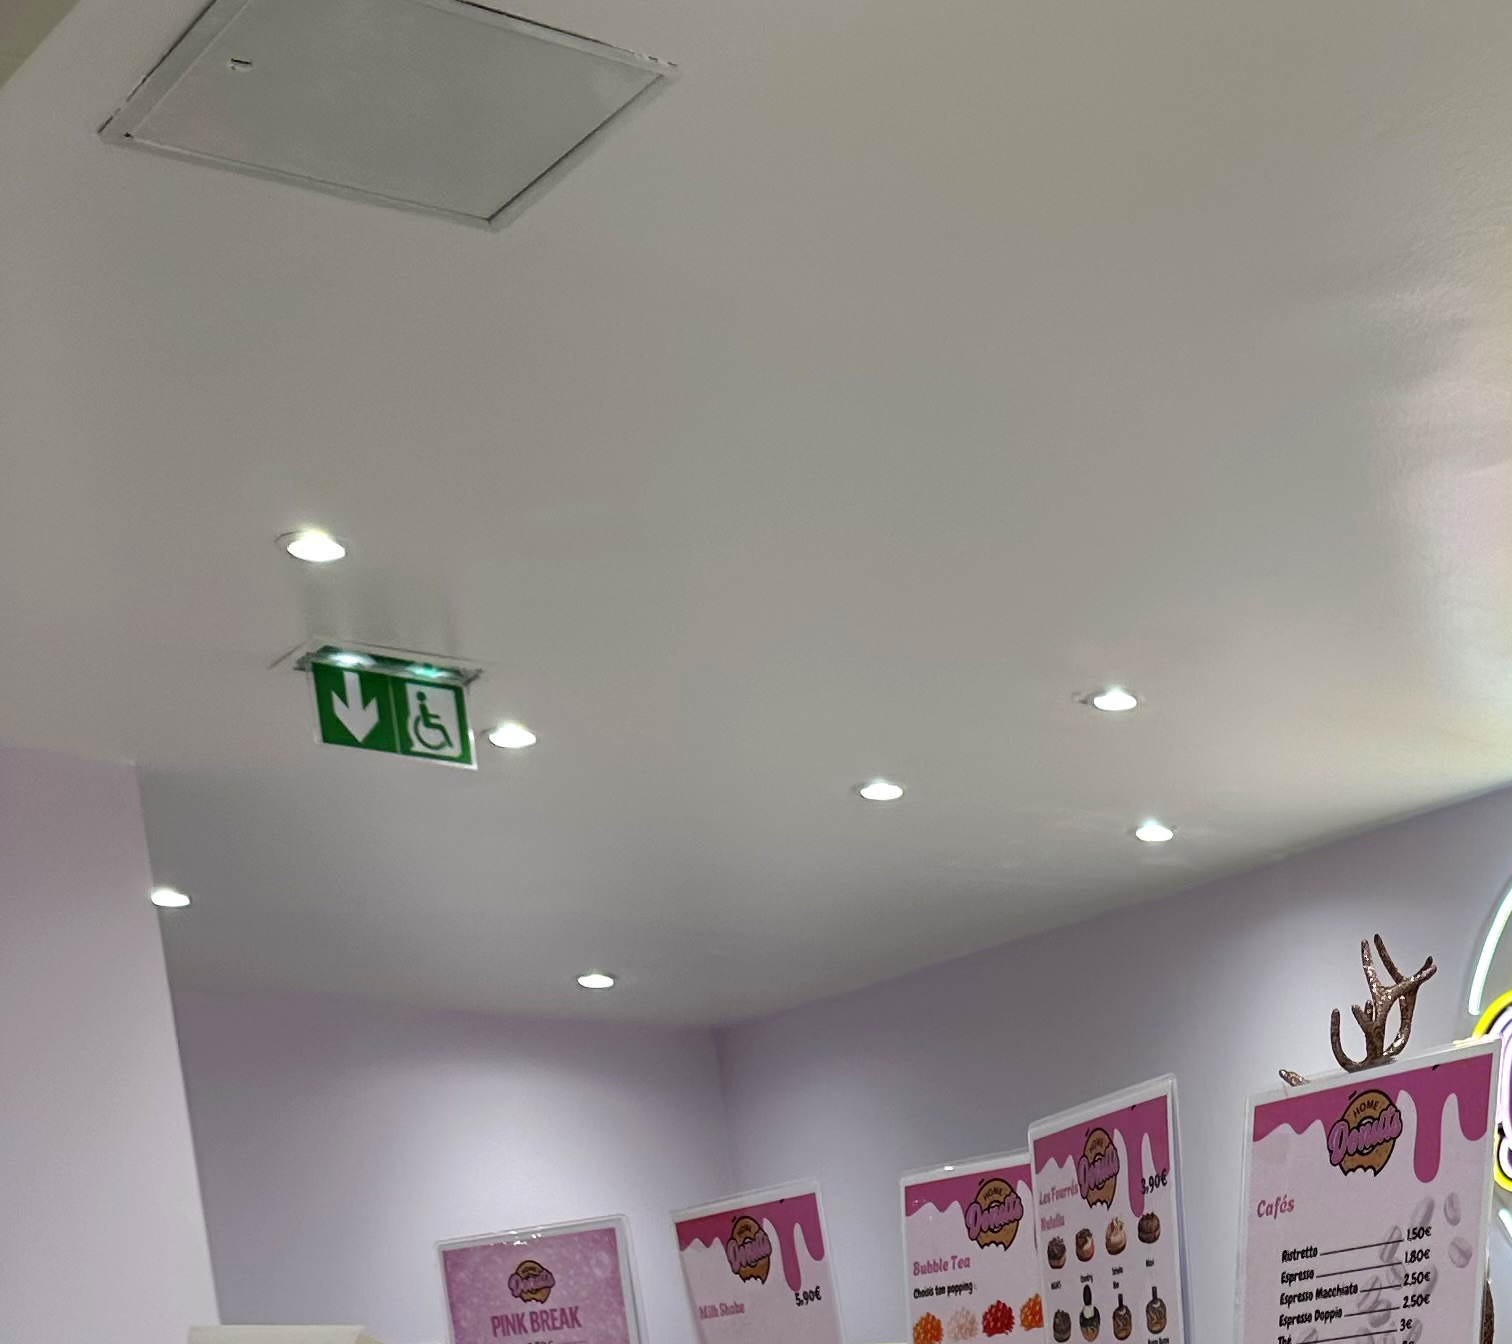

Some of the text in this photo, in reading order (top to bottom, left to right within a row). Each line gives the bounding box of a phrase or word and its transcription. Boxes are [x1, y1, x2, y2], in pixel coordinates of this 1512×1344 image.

[1353, 1100, 1380, 1118] HOME
[1257, 1194, 1295, 1219] Cafés
[1282, 1246, 1318, 1263] Ristretto
[913, 1255, 971, 1276] Bubble Tea
[1281, 1269, 1315, 1286] Espresso
[1280, 1291, 1313, 1309] Espresso
[1316, 1282, 1358, 1300] Macchiato
[491, 1305, 582, 1338] PINK BREAK
[1279, 1312, 1312, 1330] Espresso
[1315, 1306, 1343, 1325] Doppio
[1400, 1319, 1413, 1332] 3€
